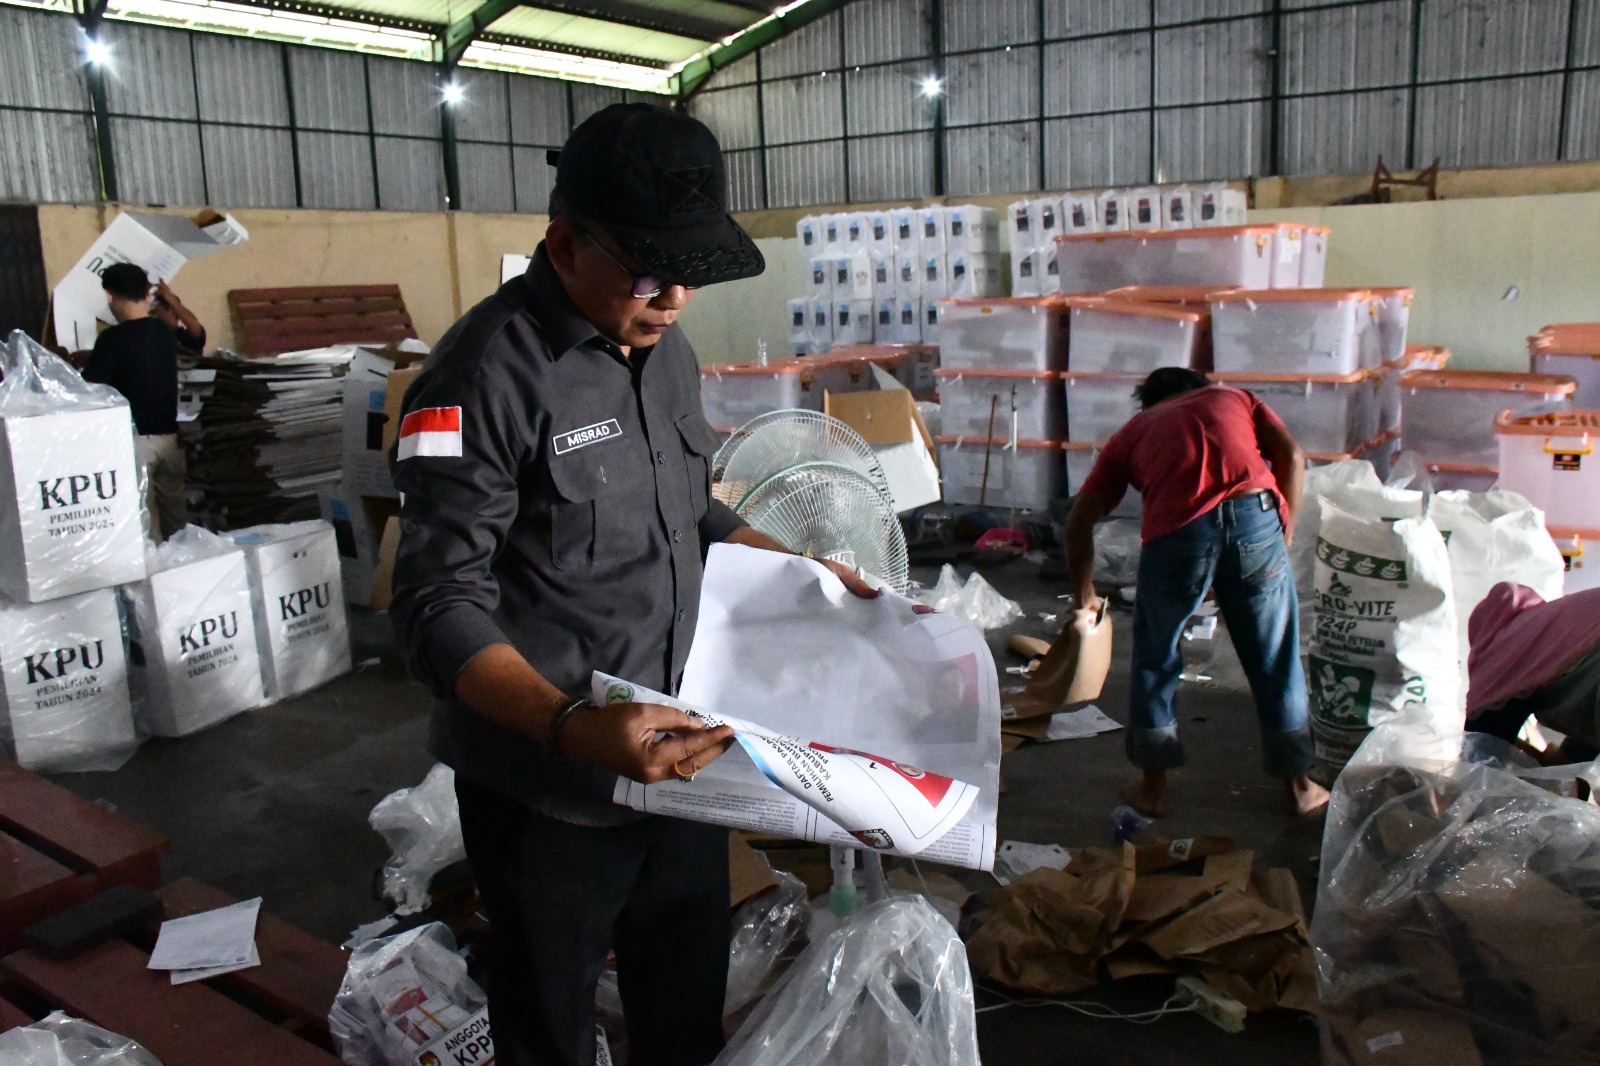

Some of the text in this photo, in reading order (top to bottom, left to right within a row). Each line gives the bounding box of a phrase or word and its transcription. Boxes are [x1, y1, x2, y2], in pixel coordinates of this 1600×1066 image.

[567, 425, 610, 447] MISRAD
[38, 470, 117, 510] KPU
[48, 523, 86, 537] TAHUN
[50, 506, 111, 524] PEMILIHAN
[279, 581, 330, 621] KPU
[178, 610, 238, 655] KPU
[23, 640, 104, 684] KPU
[35, 686, 102, 709] TAHUN 2024
[787, 758, 812, 789] DAFTAR
[800, 760, 834, 803] PEMILIHAN
[444, 1017, 489, 1052] ANGGOTA
